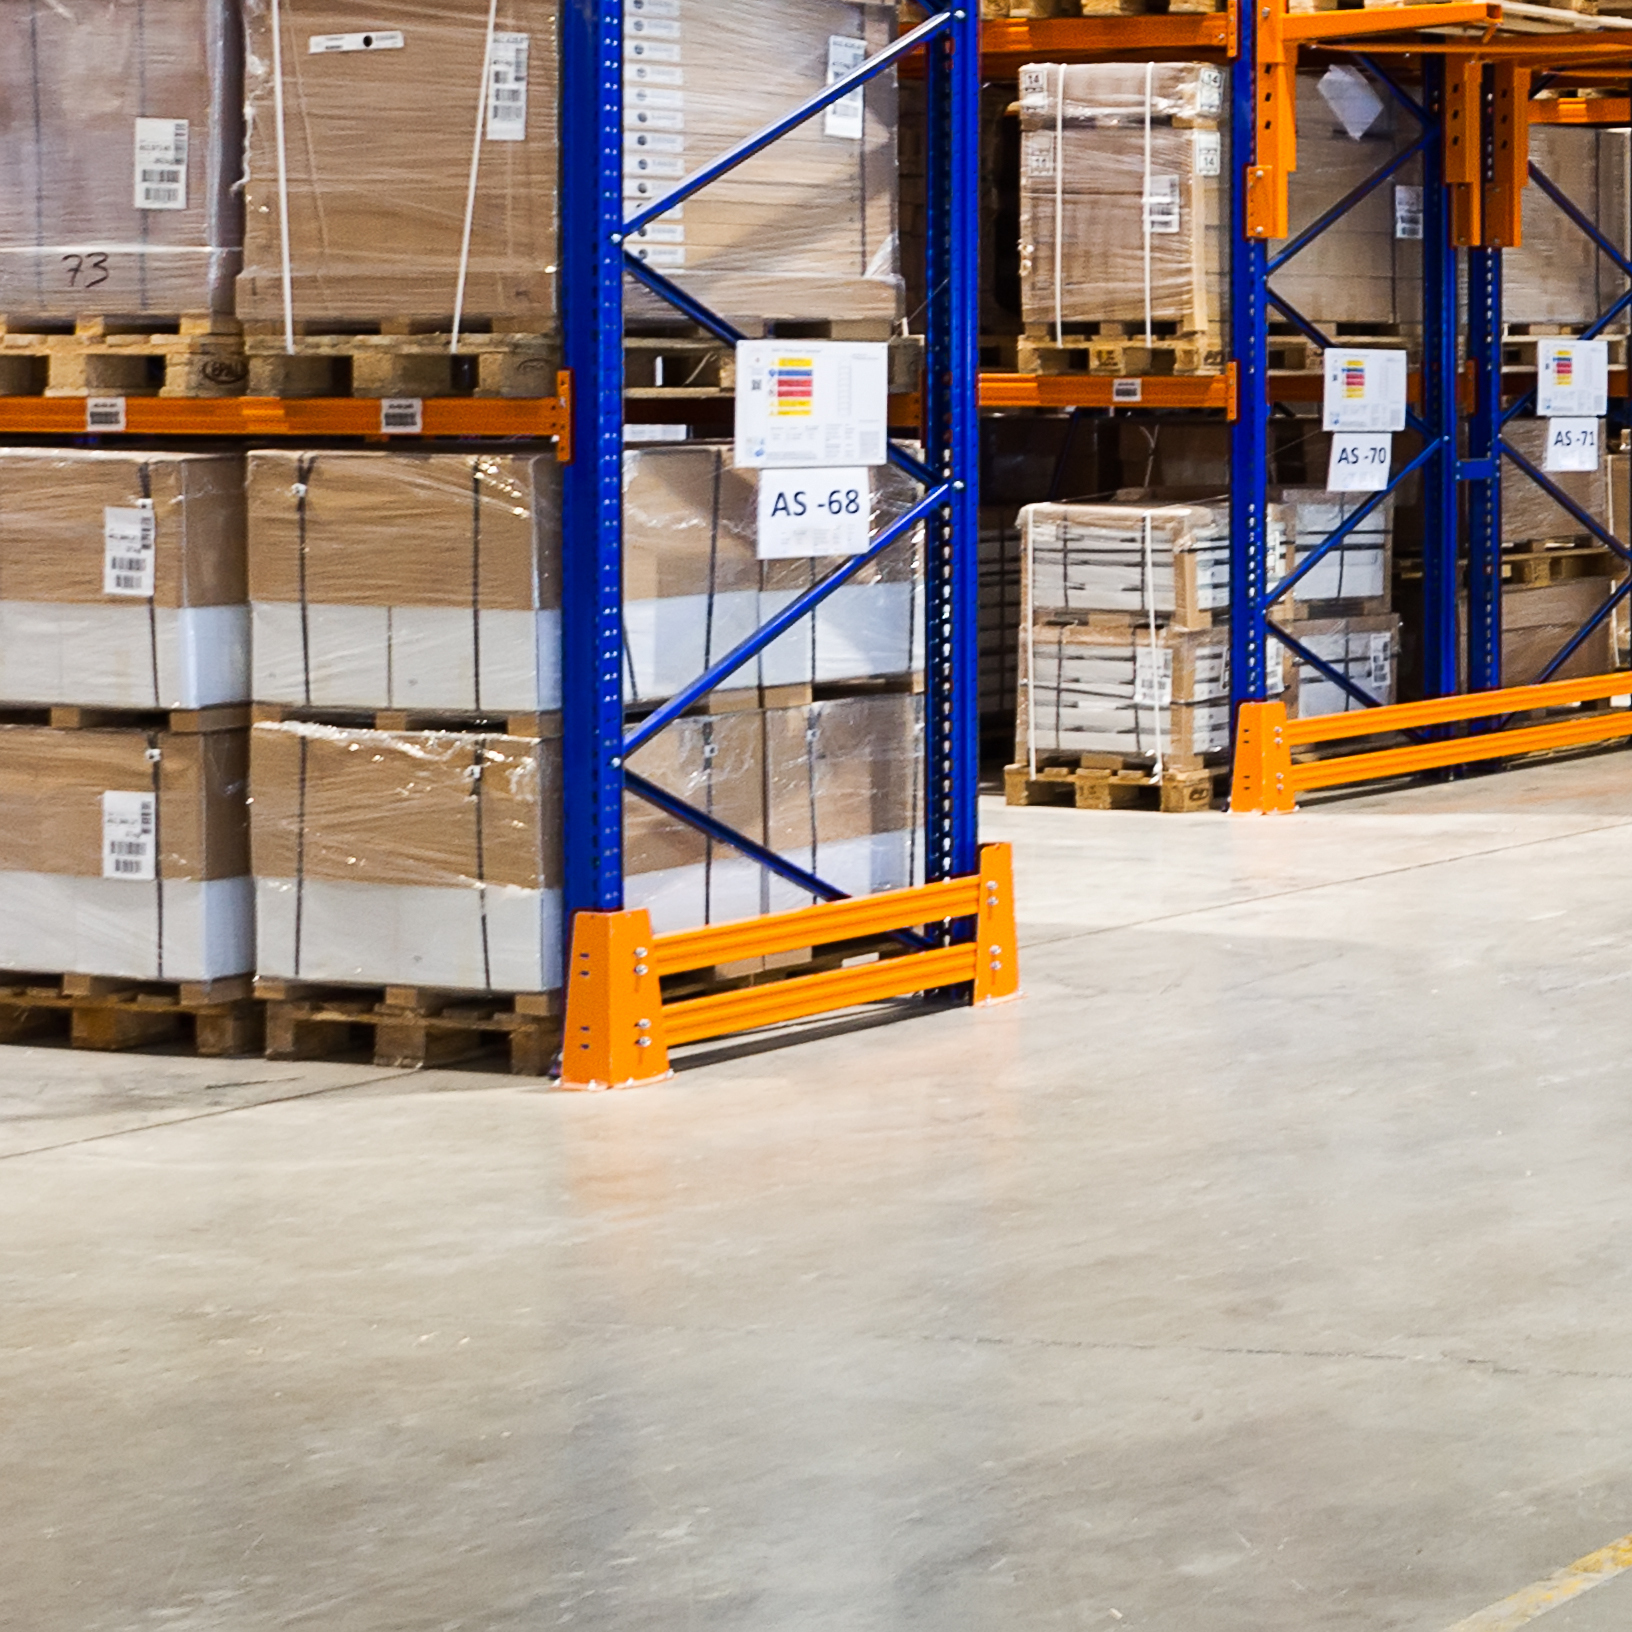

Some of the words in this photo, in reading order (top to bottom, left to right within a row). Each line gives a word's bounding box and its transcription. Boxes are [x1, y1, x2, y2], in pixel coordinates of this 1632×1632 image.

[1028, 74, 1040, 85] 14
[1204, 156, 1215, 167] 14
[61, 251, 109, 289] 73
[1554, 430, 1572, 446] AS
[1576, 430, 1595, 446] -71
[1337, 447, 1359, 464] AS
[1364, 447, 1387, 464] -70
[771, 491, 807, 517] AS
[817, 489, 860, 515] -68
